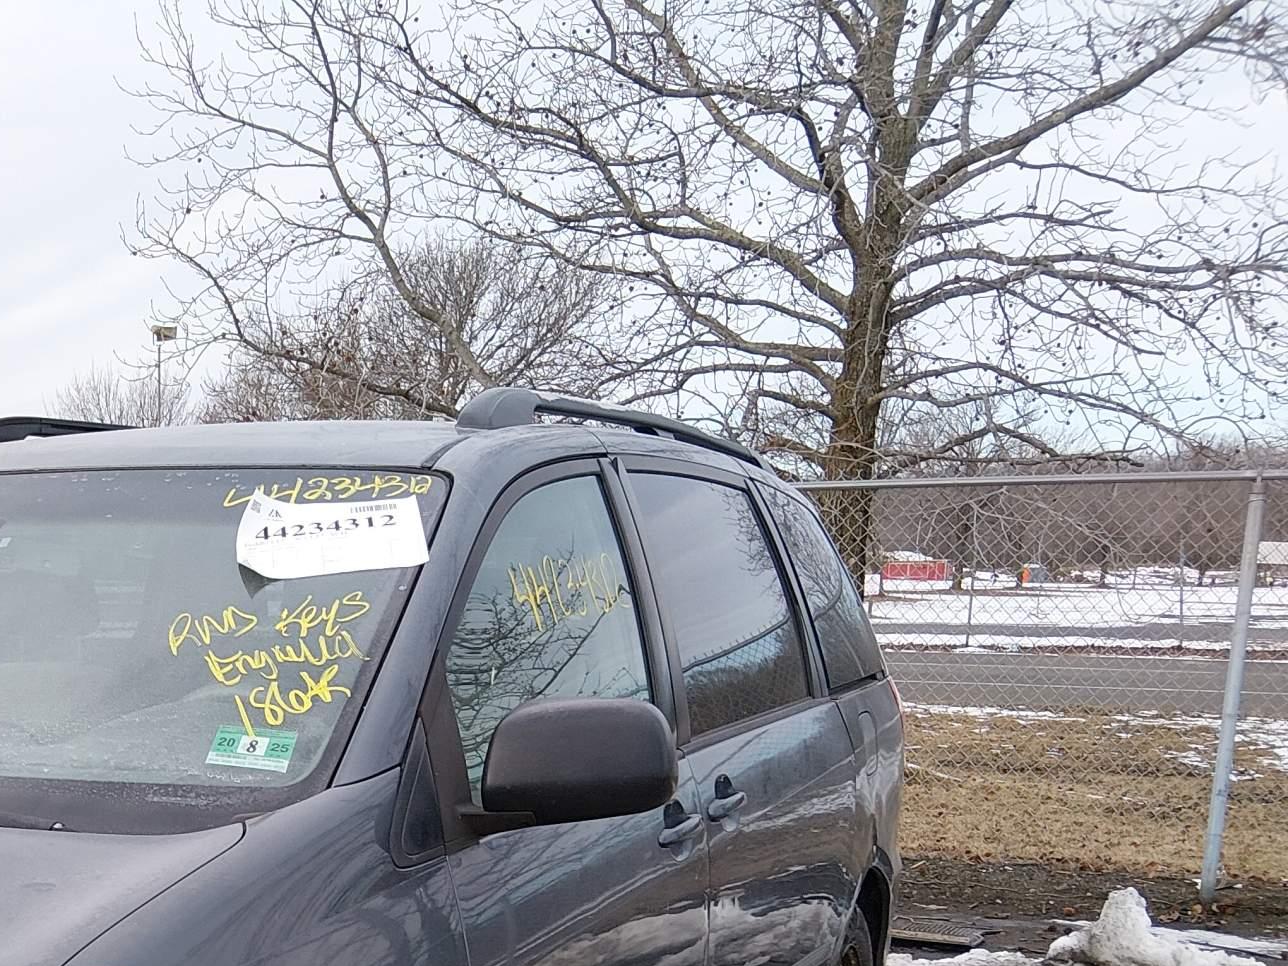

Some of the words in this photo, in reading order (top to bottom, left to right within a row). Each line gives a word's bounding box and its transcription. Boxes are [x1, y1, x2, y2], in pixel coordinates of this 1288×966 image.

[255, 514, 397, 541] 44234312
[217, 736, 236, 748] 20
[246, 739, 259, 753] 8
[271, 742, 291, 753] 25
